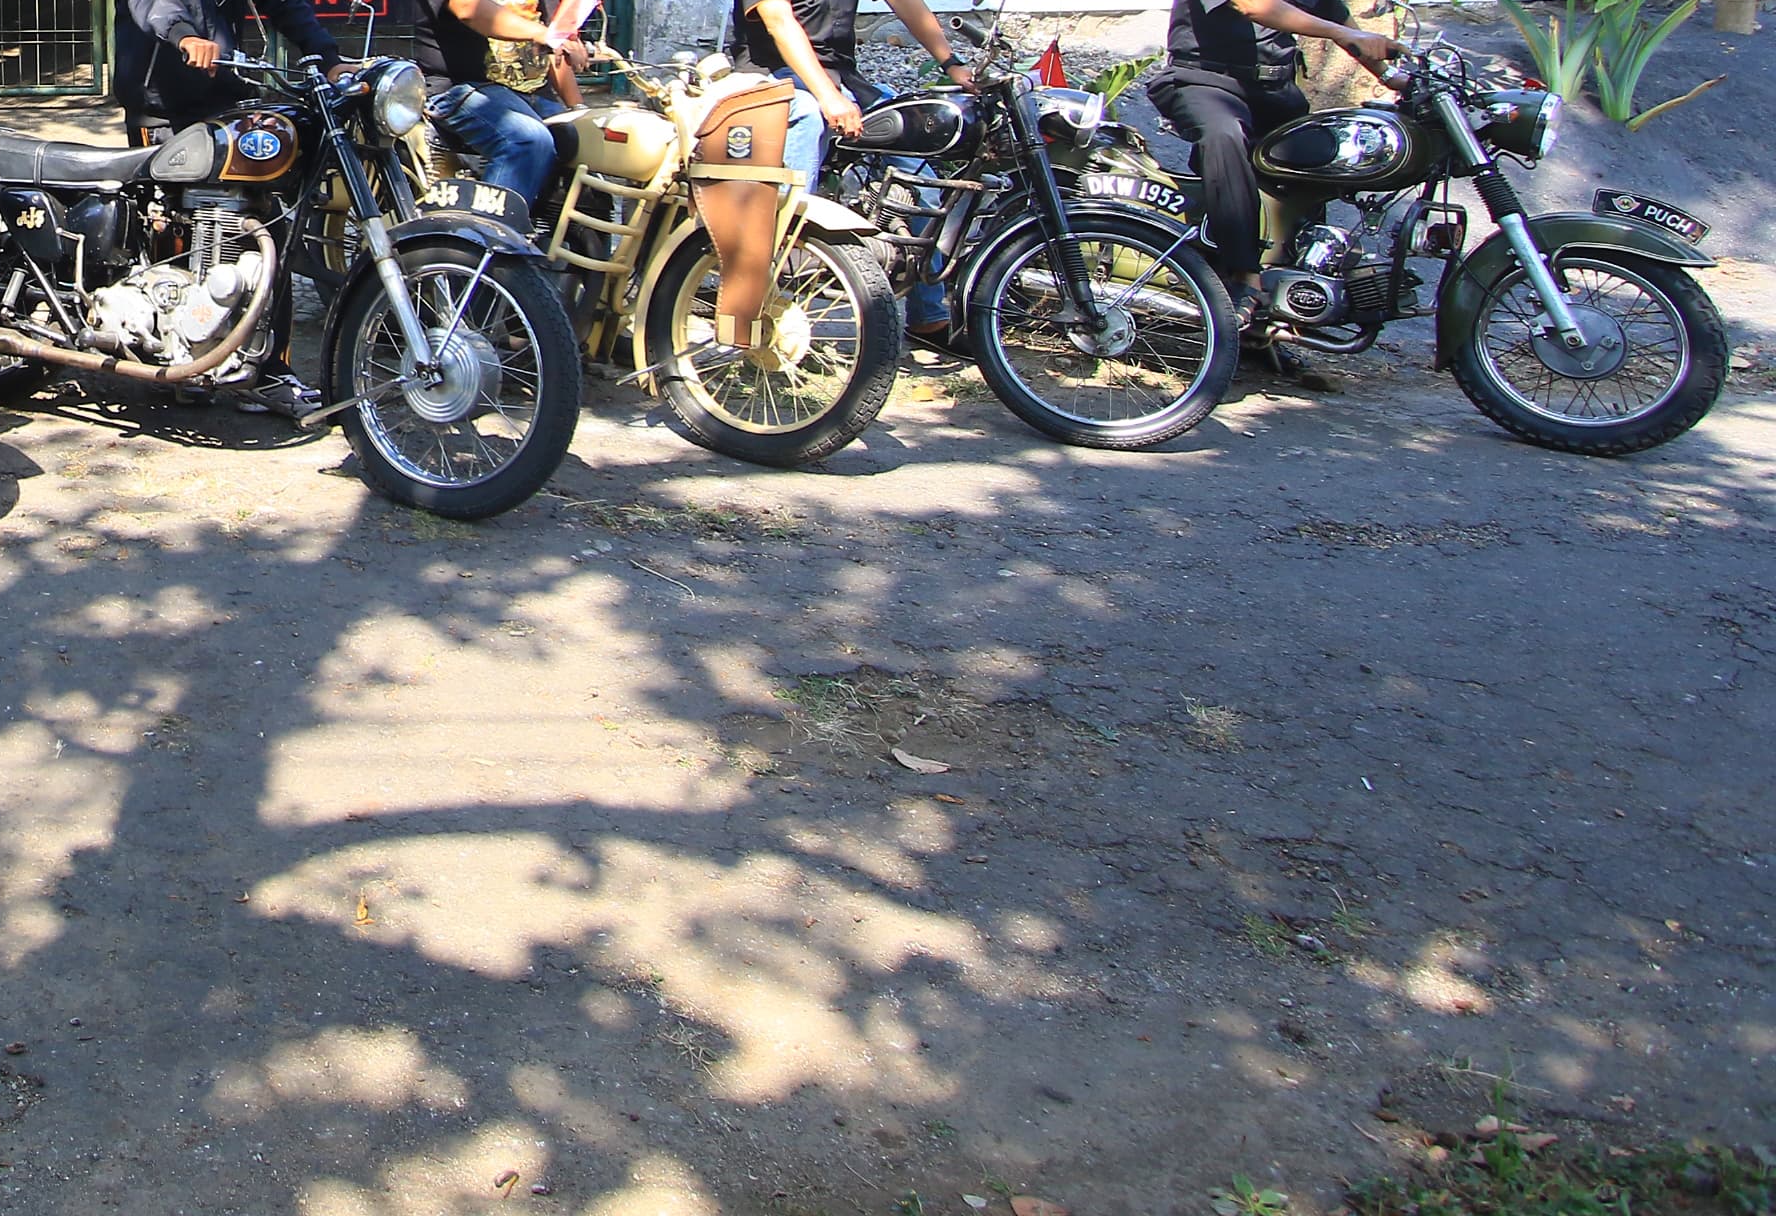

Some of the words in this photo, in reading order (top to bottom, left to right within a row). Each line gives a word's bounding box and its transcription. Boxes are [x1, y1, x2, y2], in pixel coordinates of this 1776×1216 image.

[242, 132, 274, 157] AJS
[471, 184, 507, 216] 1954
[1086, 175, 1136, 196] DKW
[1138, 181, 1185, 213] 1952
[1644, 204, 1693, 233] PUCH
